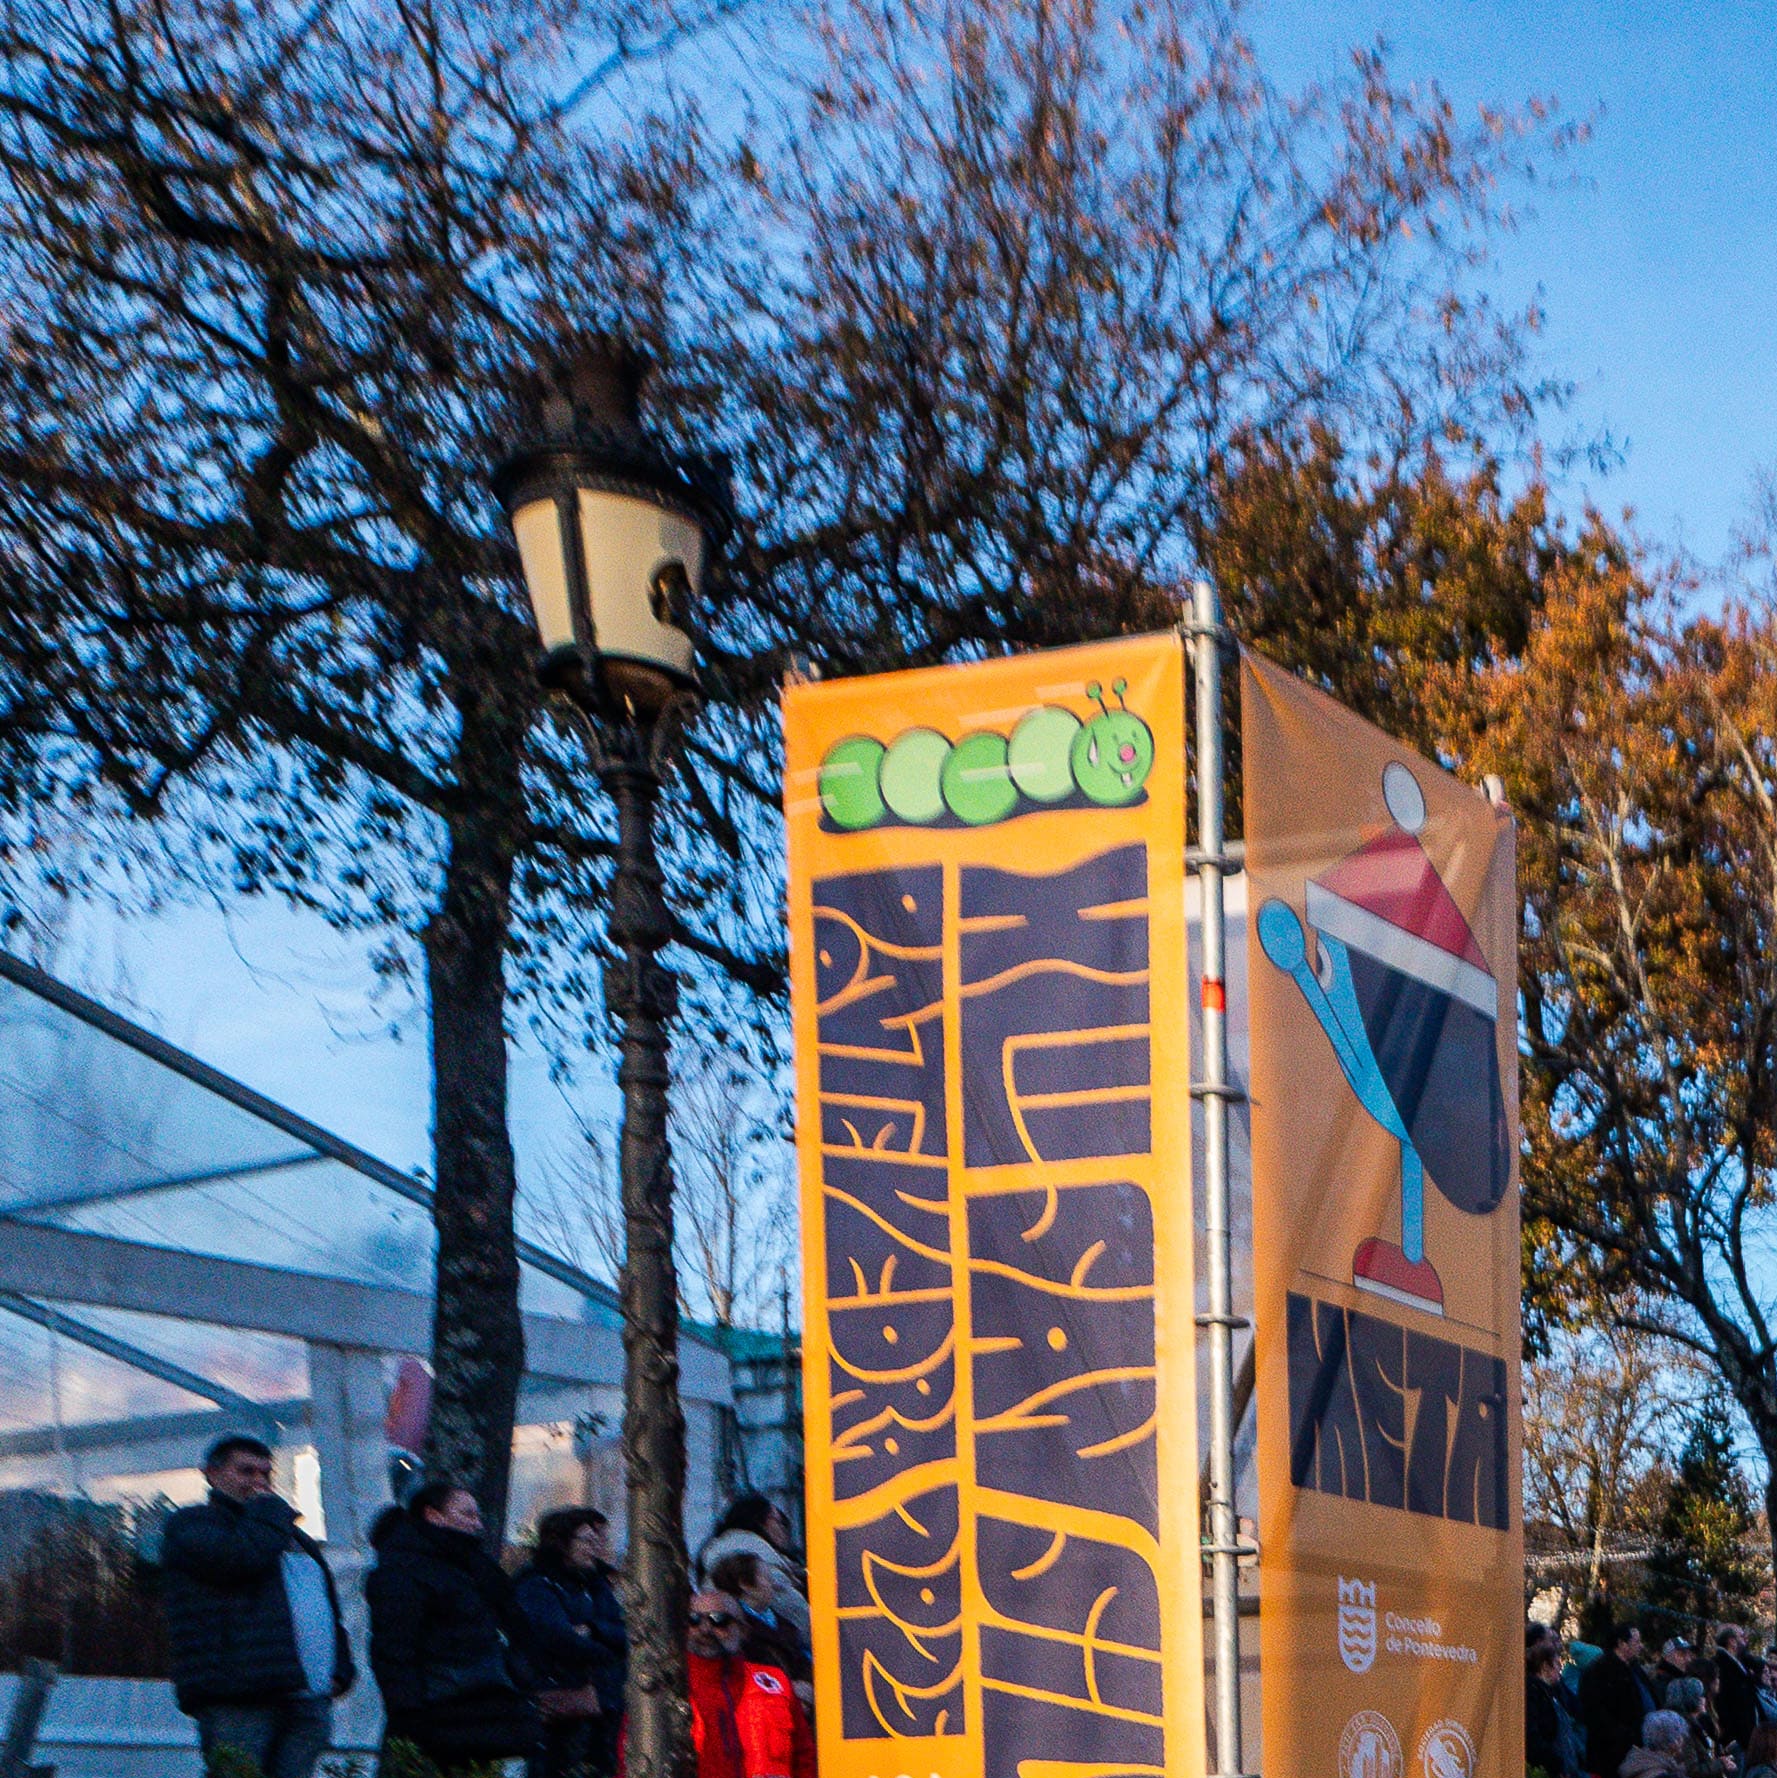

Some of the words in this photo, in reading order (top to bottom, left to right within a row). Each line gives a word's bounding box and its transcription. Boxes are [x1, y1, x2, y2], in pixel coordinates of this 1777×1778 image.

[1386, 1611, 1442, 1638] Concello
[1386, 1635, 1402, 1654] de
[1404, 1636, 1478, 1664] Pontevedra
